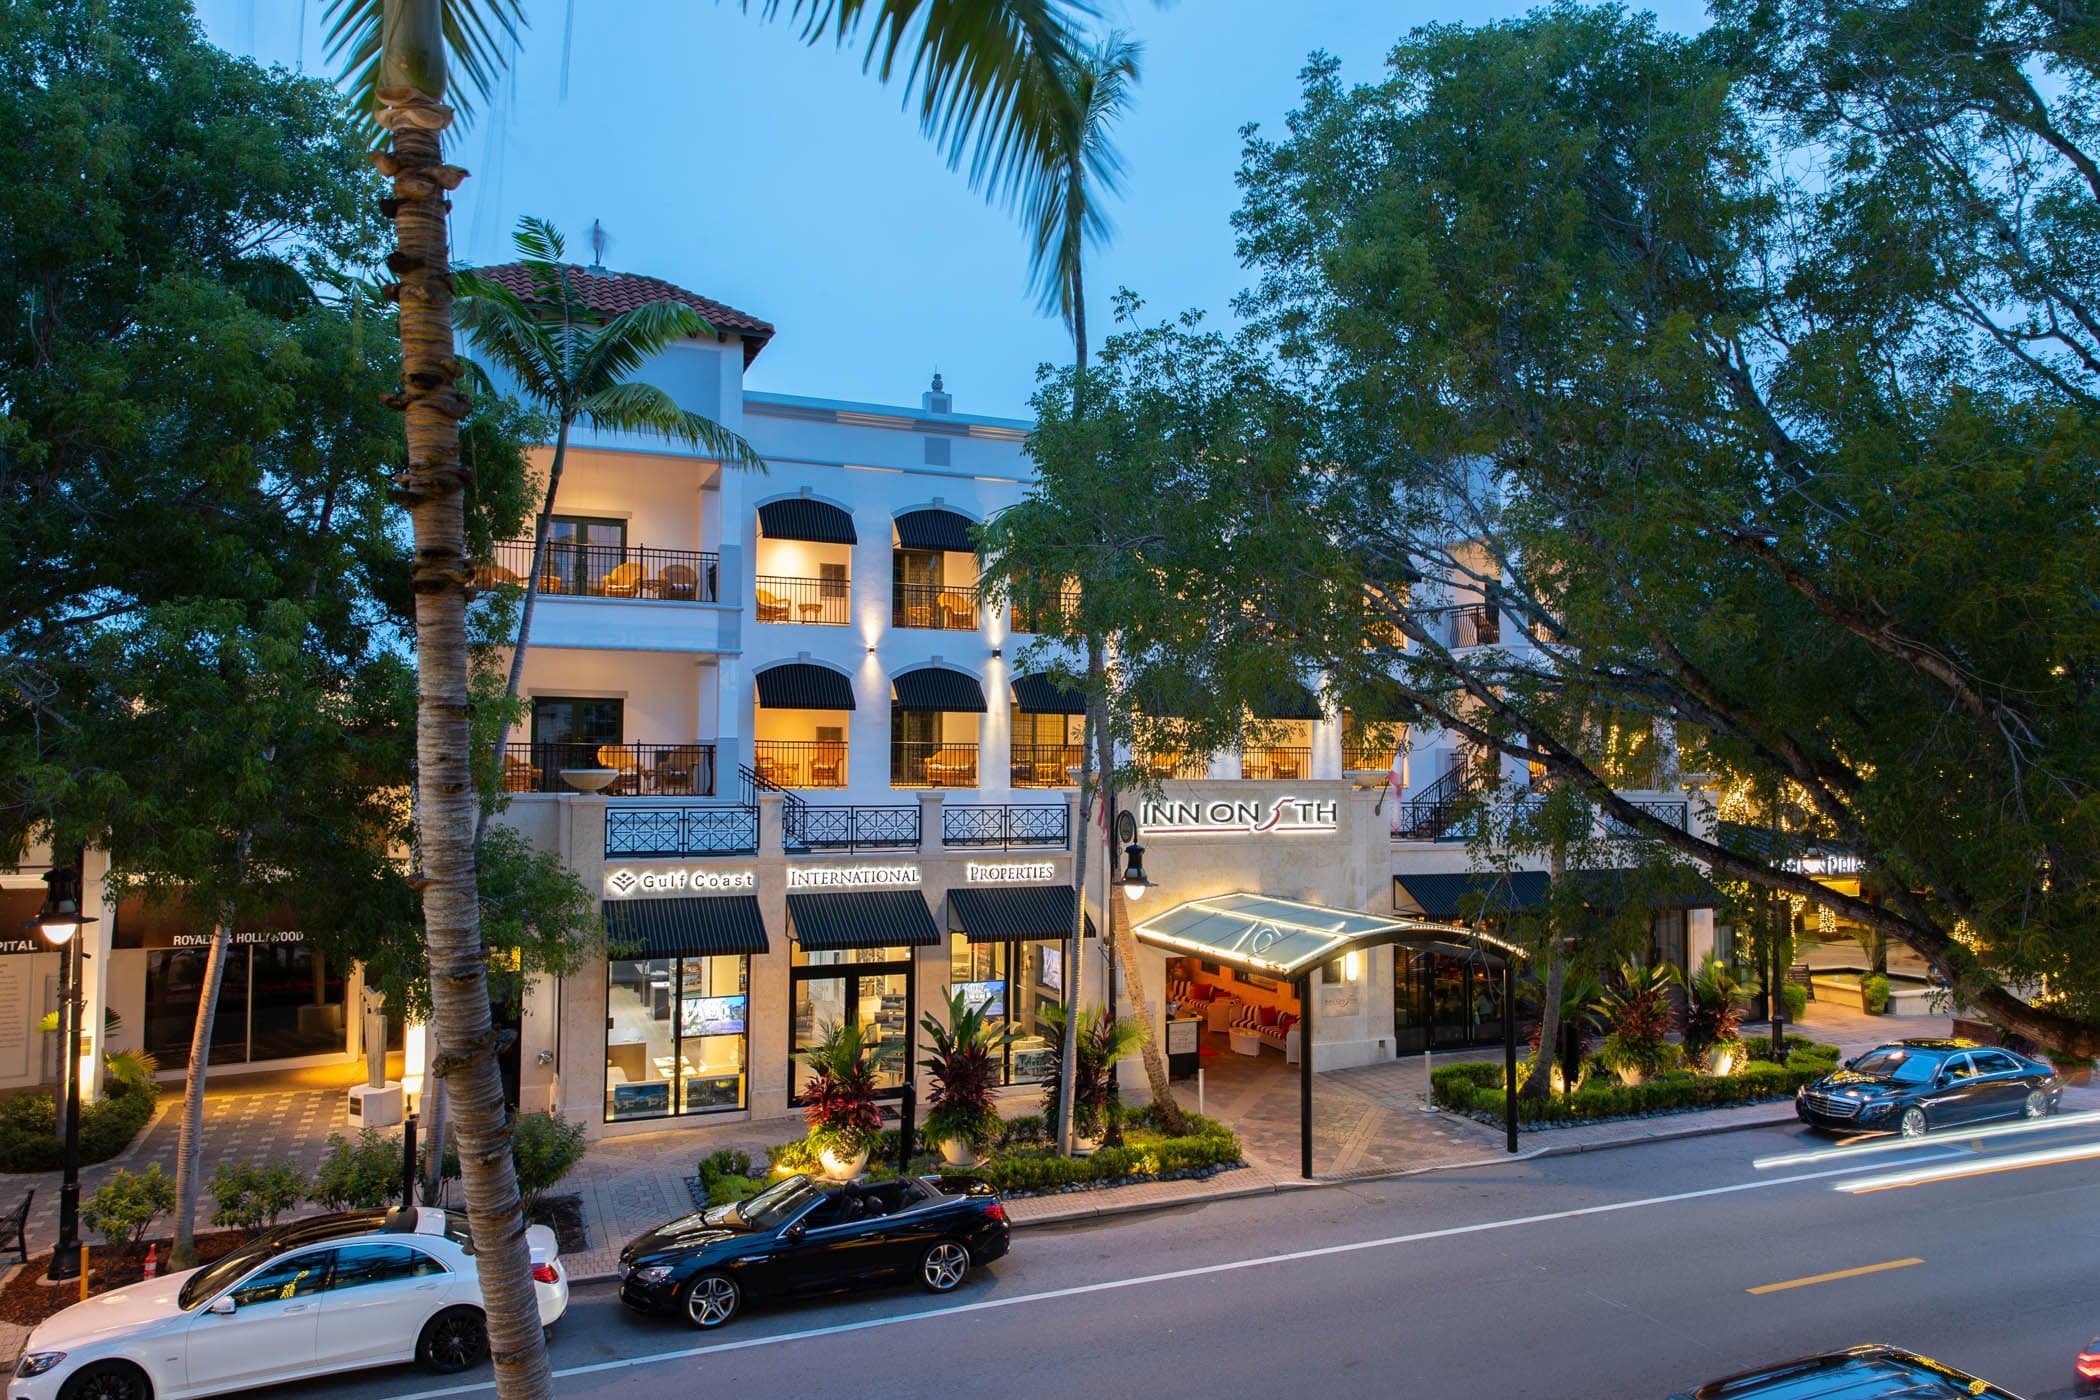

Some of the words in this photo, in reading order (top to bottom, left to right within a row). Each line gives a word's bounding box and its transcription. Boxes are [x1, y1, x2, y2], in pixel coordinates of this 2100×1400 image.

[1143, 803, 1200, 825] INN
[1210, 803, 1260, 823] ON
[643, 872, 686, 888] Gulf
[695, 873, 753, 888] Coast
[790, 869, 920, 886] INTERNATIONAL
[969, 865, 1054, 881] PROPERTIES
[173, 934, 214, 946] ROYALT
